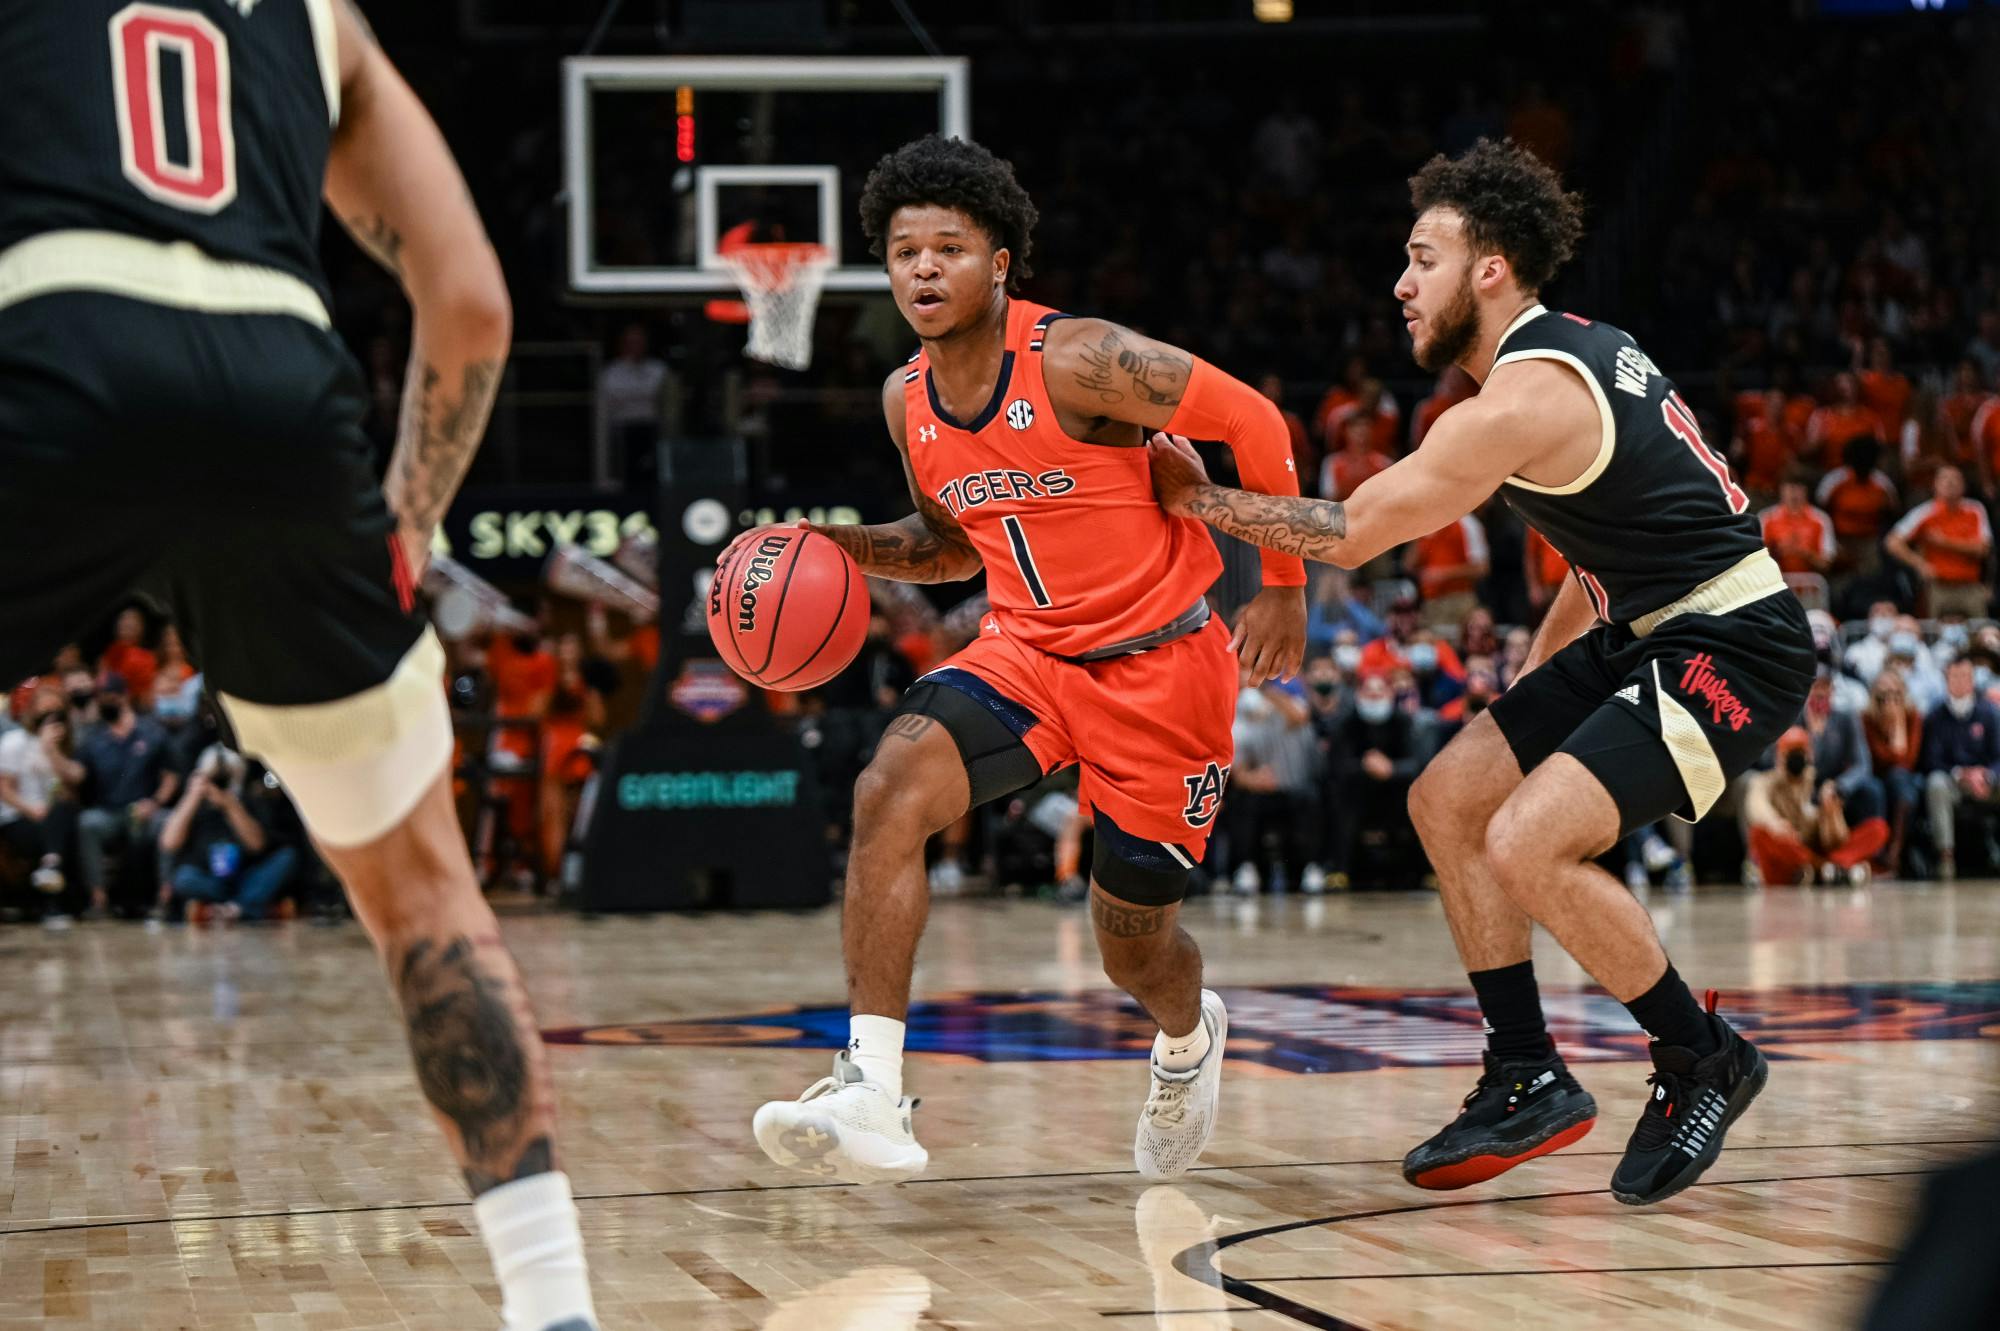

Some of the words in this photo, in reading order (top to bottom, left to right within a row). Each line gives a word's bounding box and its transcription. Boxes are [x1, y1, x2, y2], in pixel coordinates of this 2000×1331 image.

[108, 1, 238, 217] 0
[1007, 399, 1034, 430] SEC
[937, 468, 1076, 518] TIGERS
[738, 535, 793, 633] Wilson
[1001, 515, 1053, 608] 1
[1680, 652, 1752, 732] Huskers
[1682, 1094, 1728, 1159] ADVISORY
